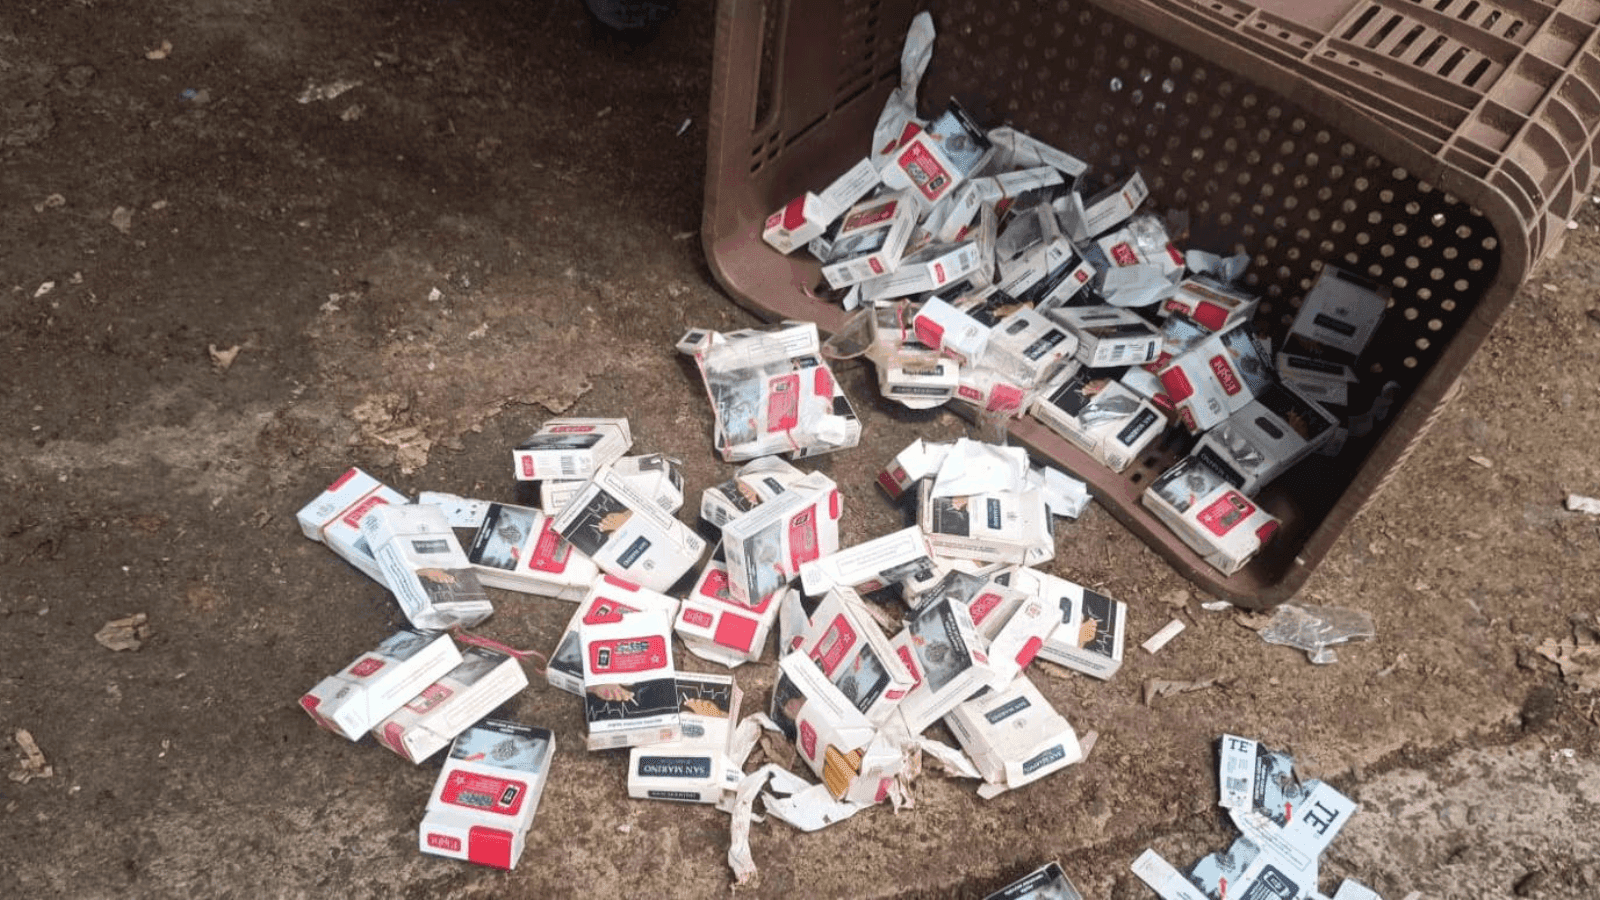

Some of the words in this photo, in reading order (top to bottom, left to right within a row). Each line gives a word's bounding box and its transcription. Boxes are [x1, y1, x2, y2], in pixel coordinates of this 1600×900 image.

[1228, 738, 1248, 753] TE
[643, 763, 684, 775] MARINO
[685, 765, 705, 775] SAN
[1302, 800, 1340, 835] TE
